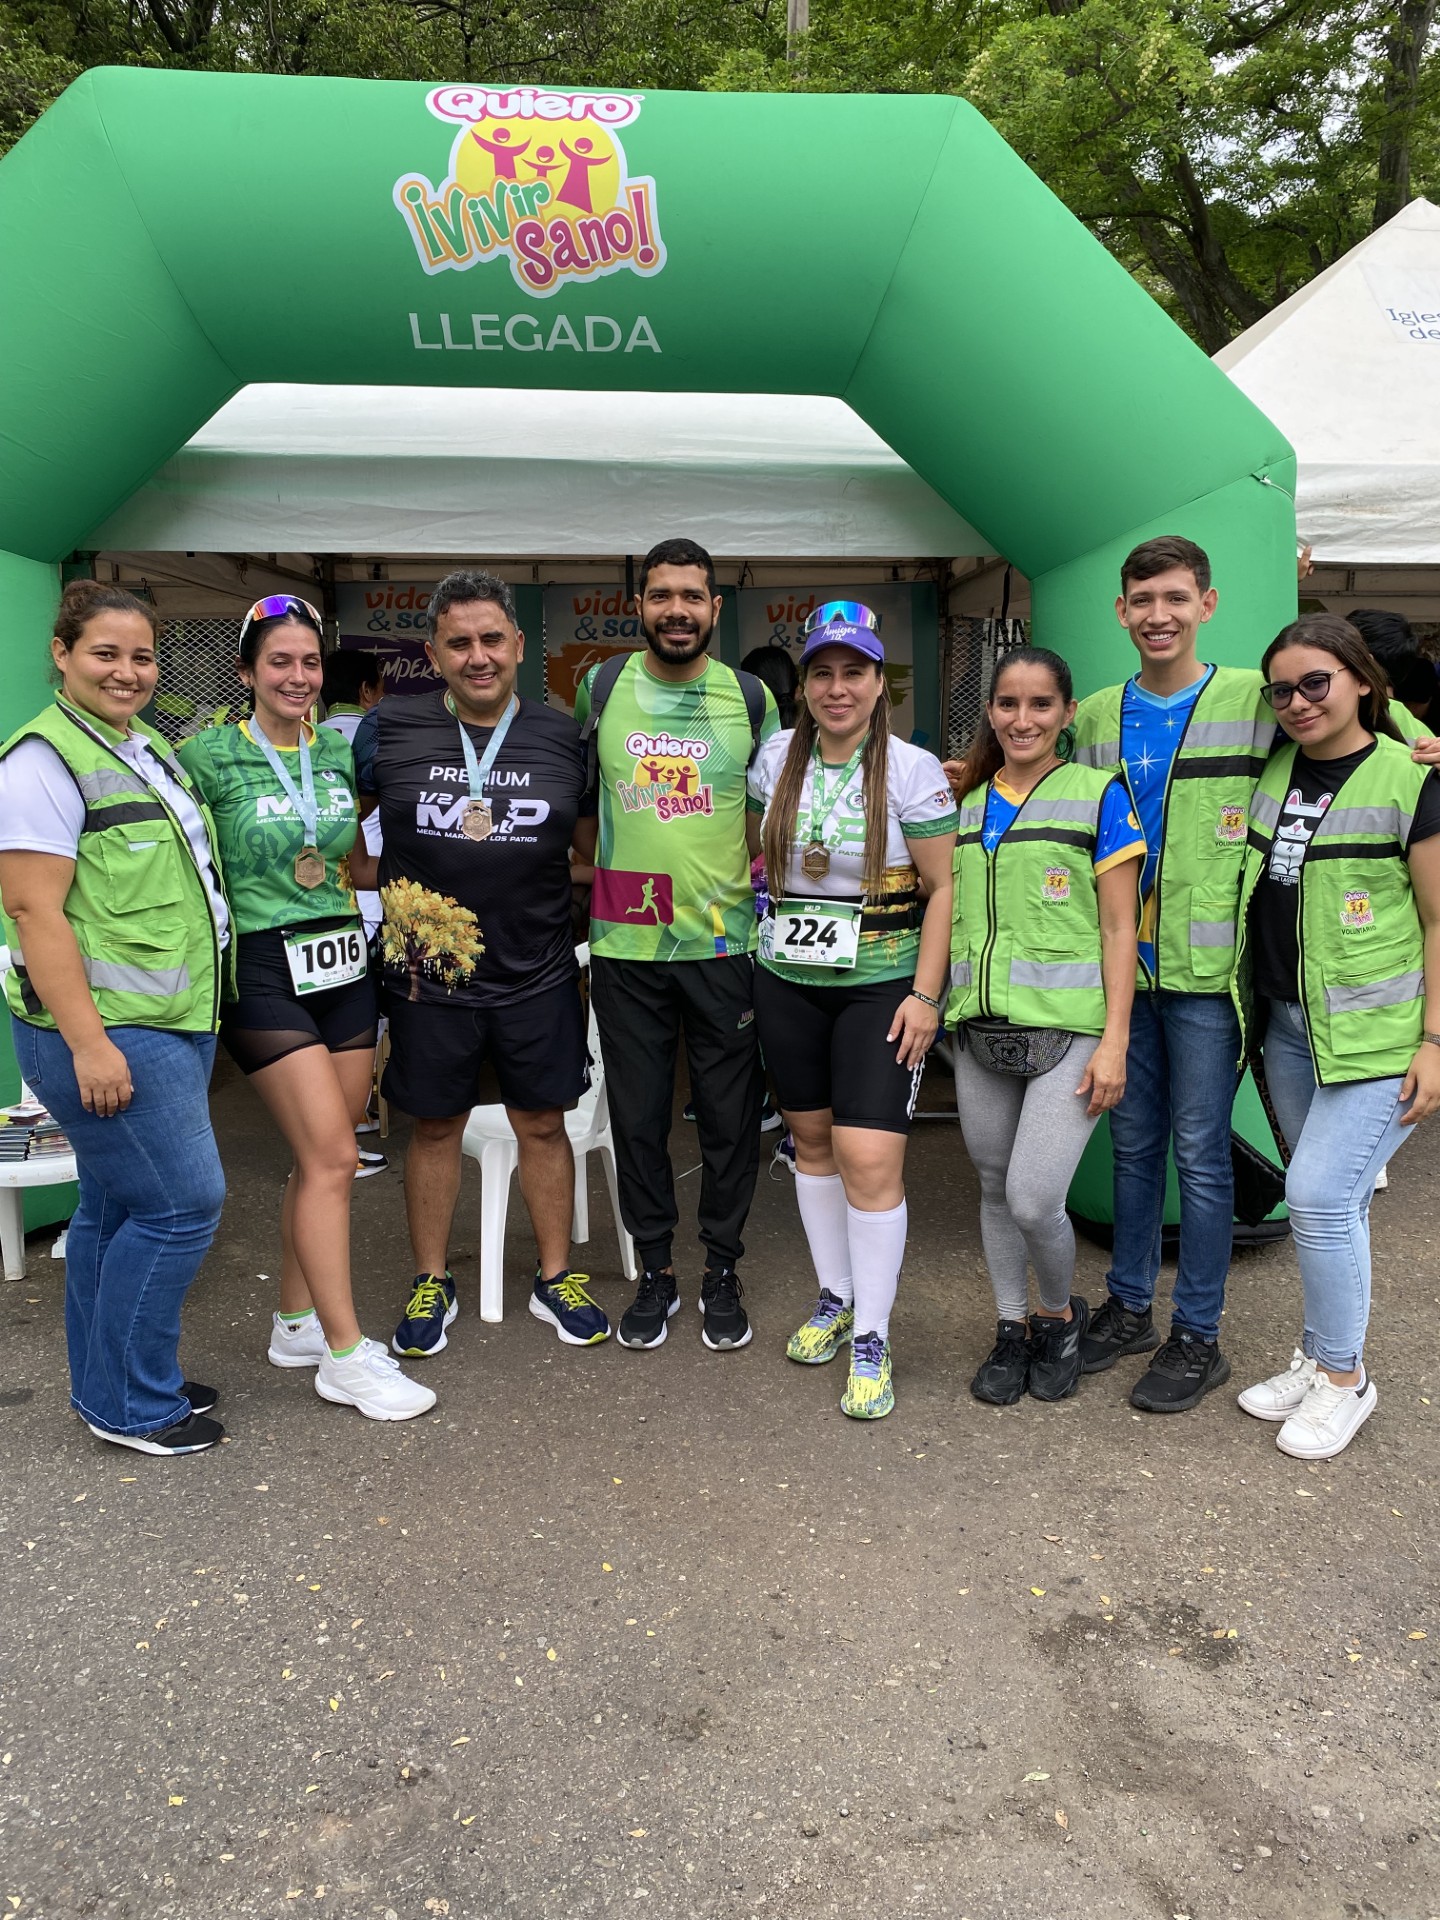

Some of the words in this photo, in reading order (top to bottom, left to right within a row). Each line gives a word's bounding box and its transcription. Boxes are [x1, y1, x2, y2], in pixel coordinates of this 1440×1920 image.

[432, 86, 634, 124] Quiero
[408, 312, 663, 354] LLEGADA
[367, 609, 391, 632] &
[574, 616, 598, 641] &
[768, 623, 792, 648] &
[626, 732, 709, 760] Quiero
[429, 766, 530, 787] PREIUM
[419, 791, 454, 805] 1/2
[256, 816, 281, 825] MEDIA
[416, 827, 442, 837] MEDIA
[785, 917, 838, 948] 224
[1341, 925, 1377, 935] VOLUNTARIO
[301, 933, 360, 974] 1016
